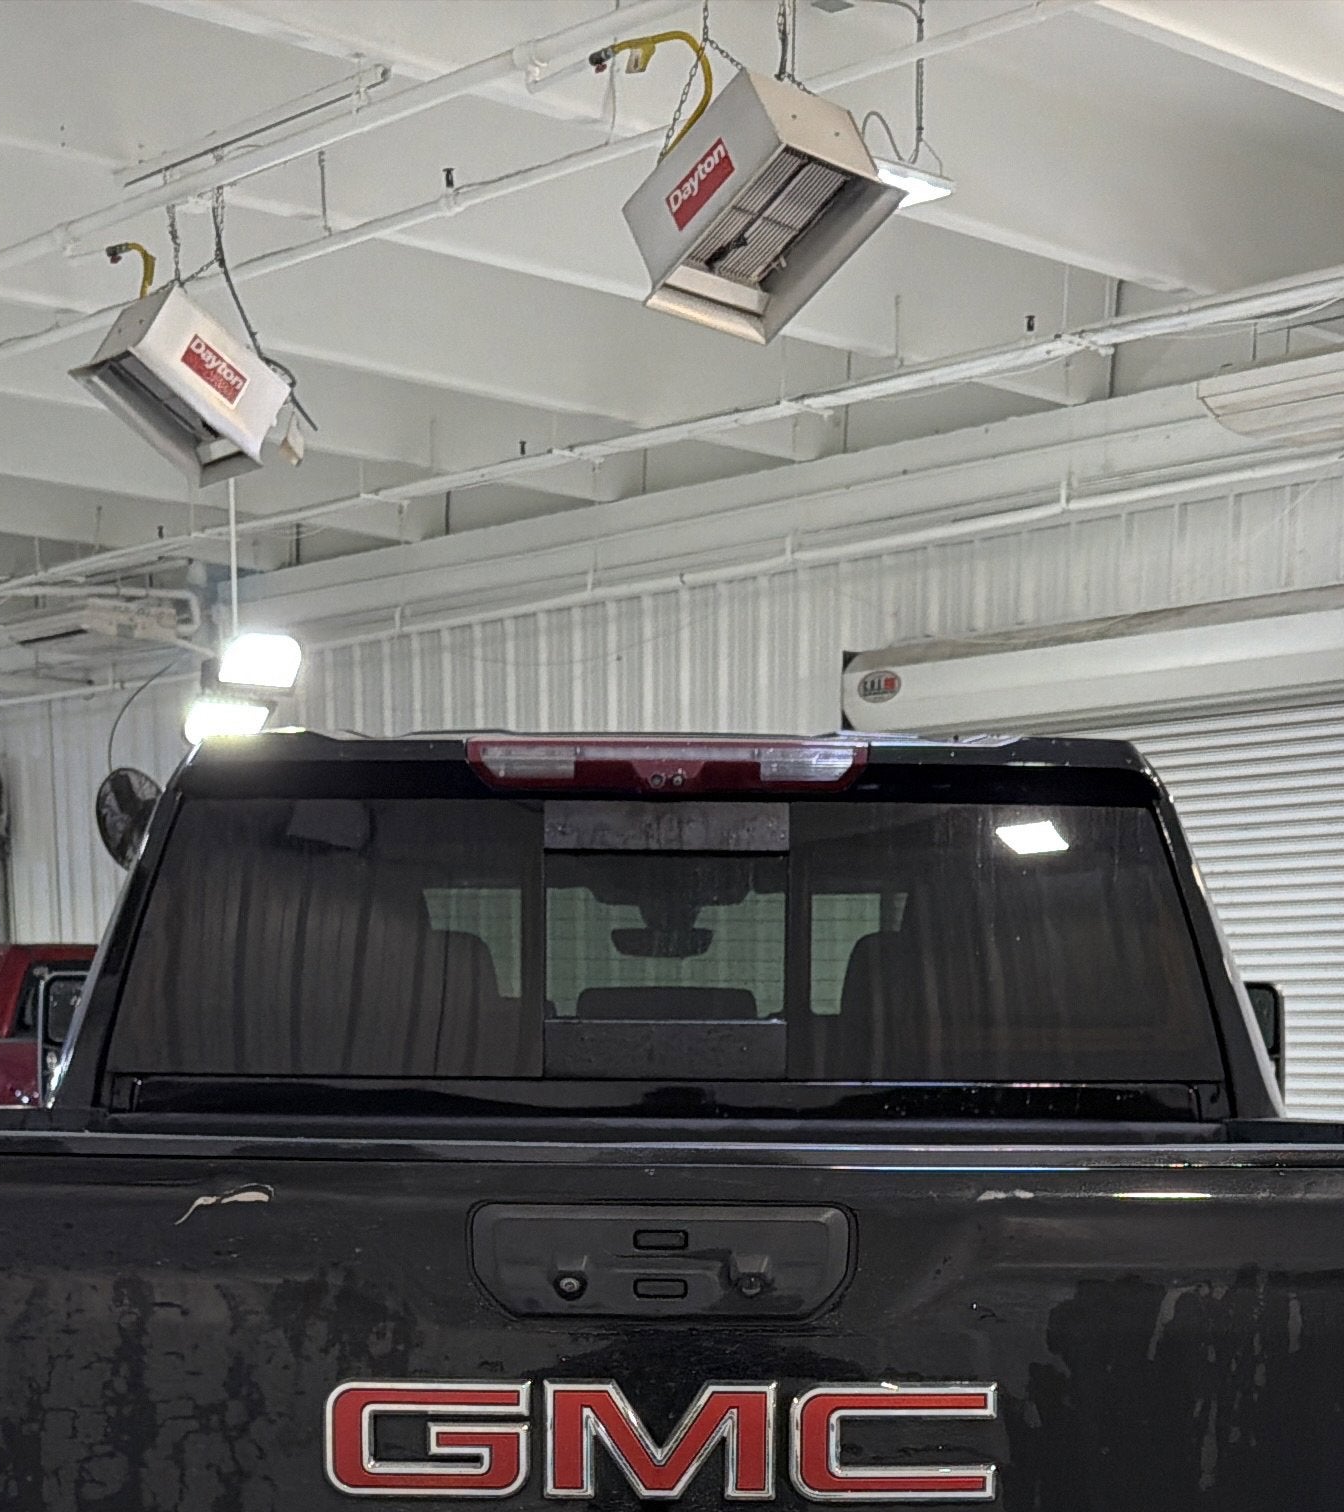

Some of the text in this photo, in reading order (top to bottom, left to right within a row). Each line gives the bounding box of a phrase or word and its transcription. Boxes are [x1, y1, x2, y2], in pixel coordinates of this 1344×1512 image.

[669, 143, 726, 213] Dayton
[190, 338, 244, 390] Dayton
[325, 1379, 998, 1500] GMC
